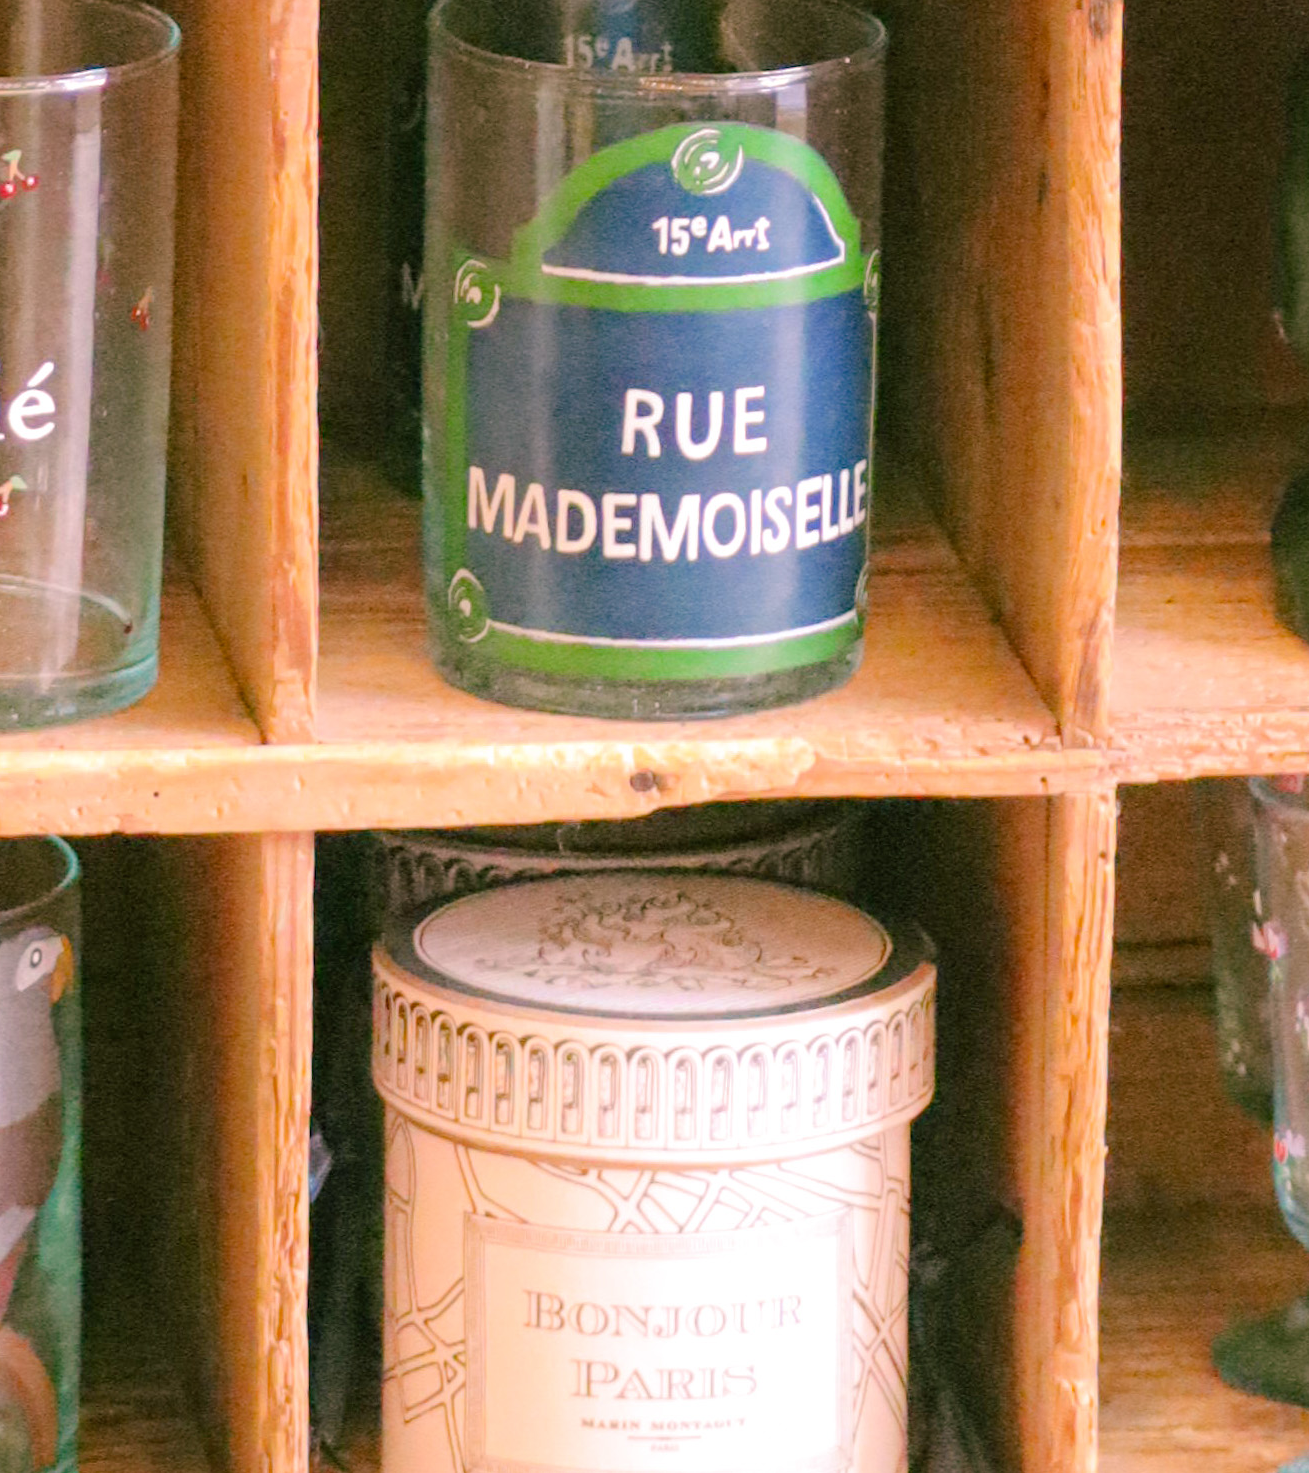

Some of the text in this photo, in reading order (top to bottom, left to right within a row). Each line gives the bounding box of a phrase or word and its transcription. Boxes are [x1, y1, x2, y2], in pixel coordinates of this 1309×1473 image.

[651, 214, 771, 256] 15e Arrt
[620, 384, 769, 459] RUE
[466, 457, 868, 563] MADEMOISELLE
[522, 1288, 803, 1339] BONJOUR
[570, 1357, 758, 1402] PARIS
